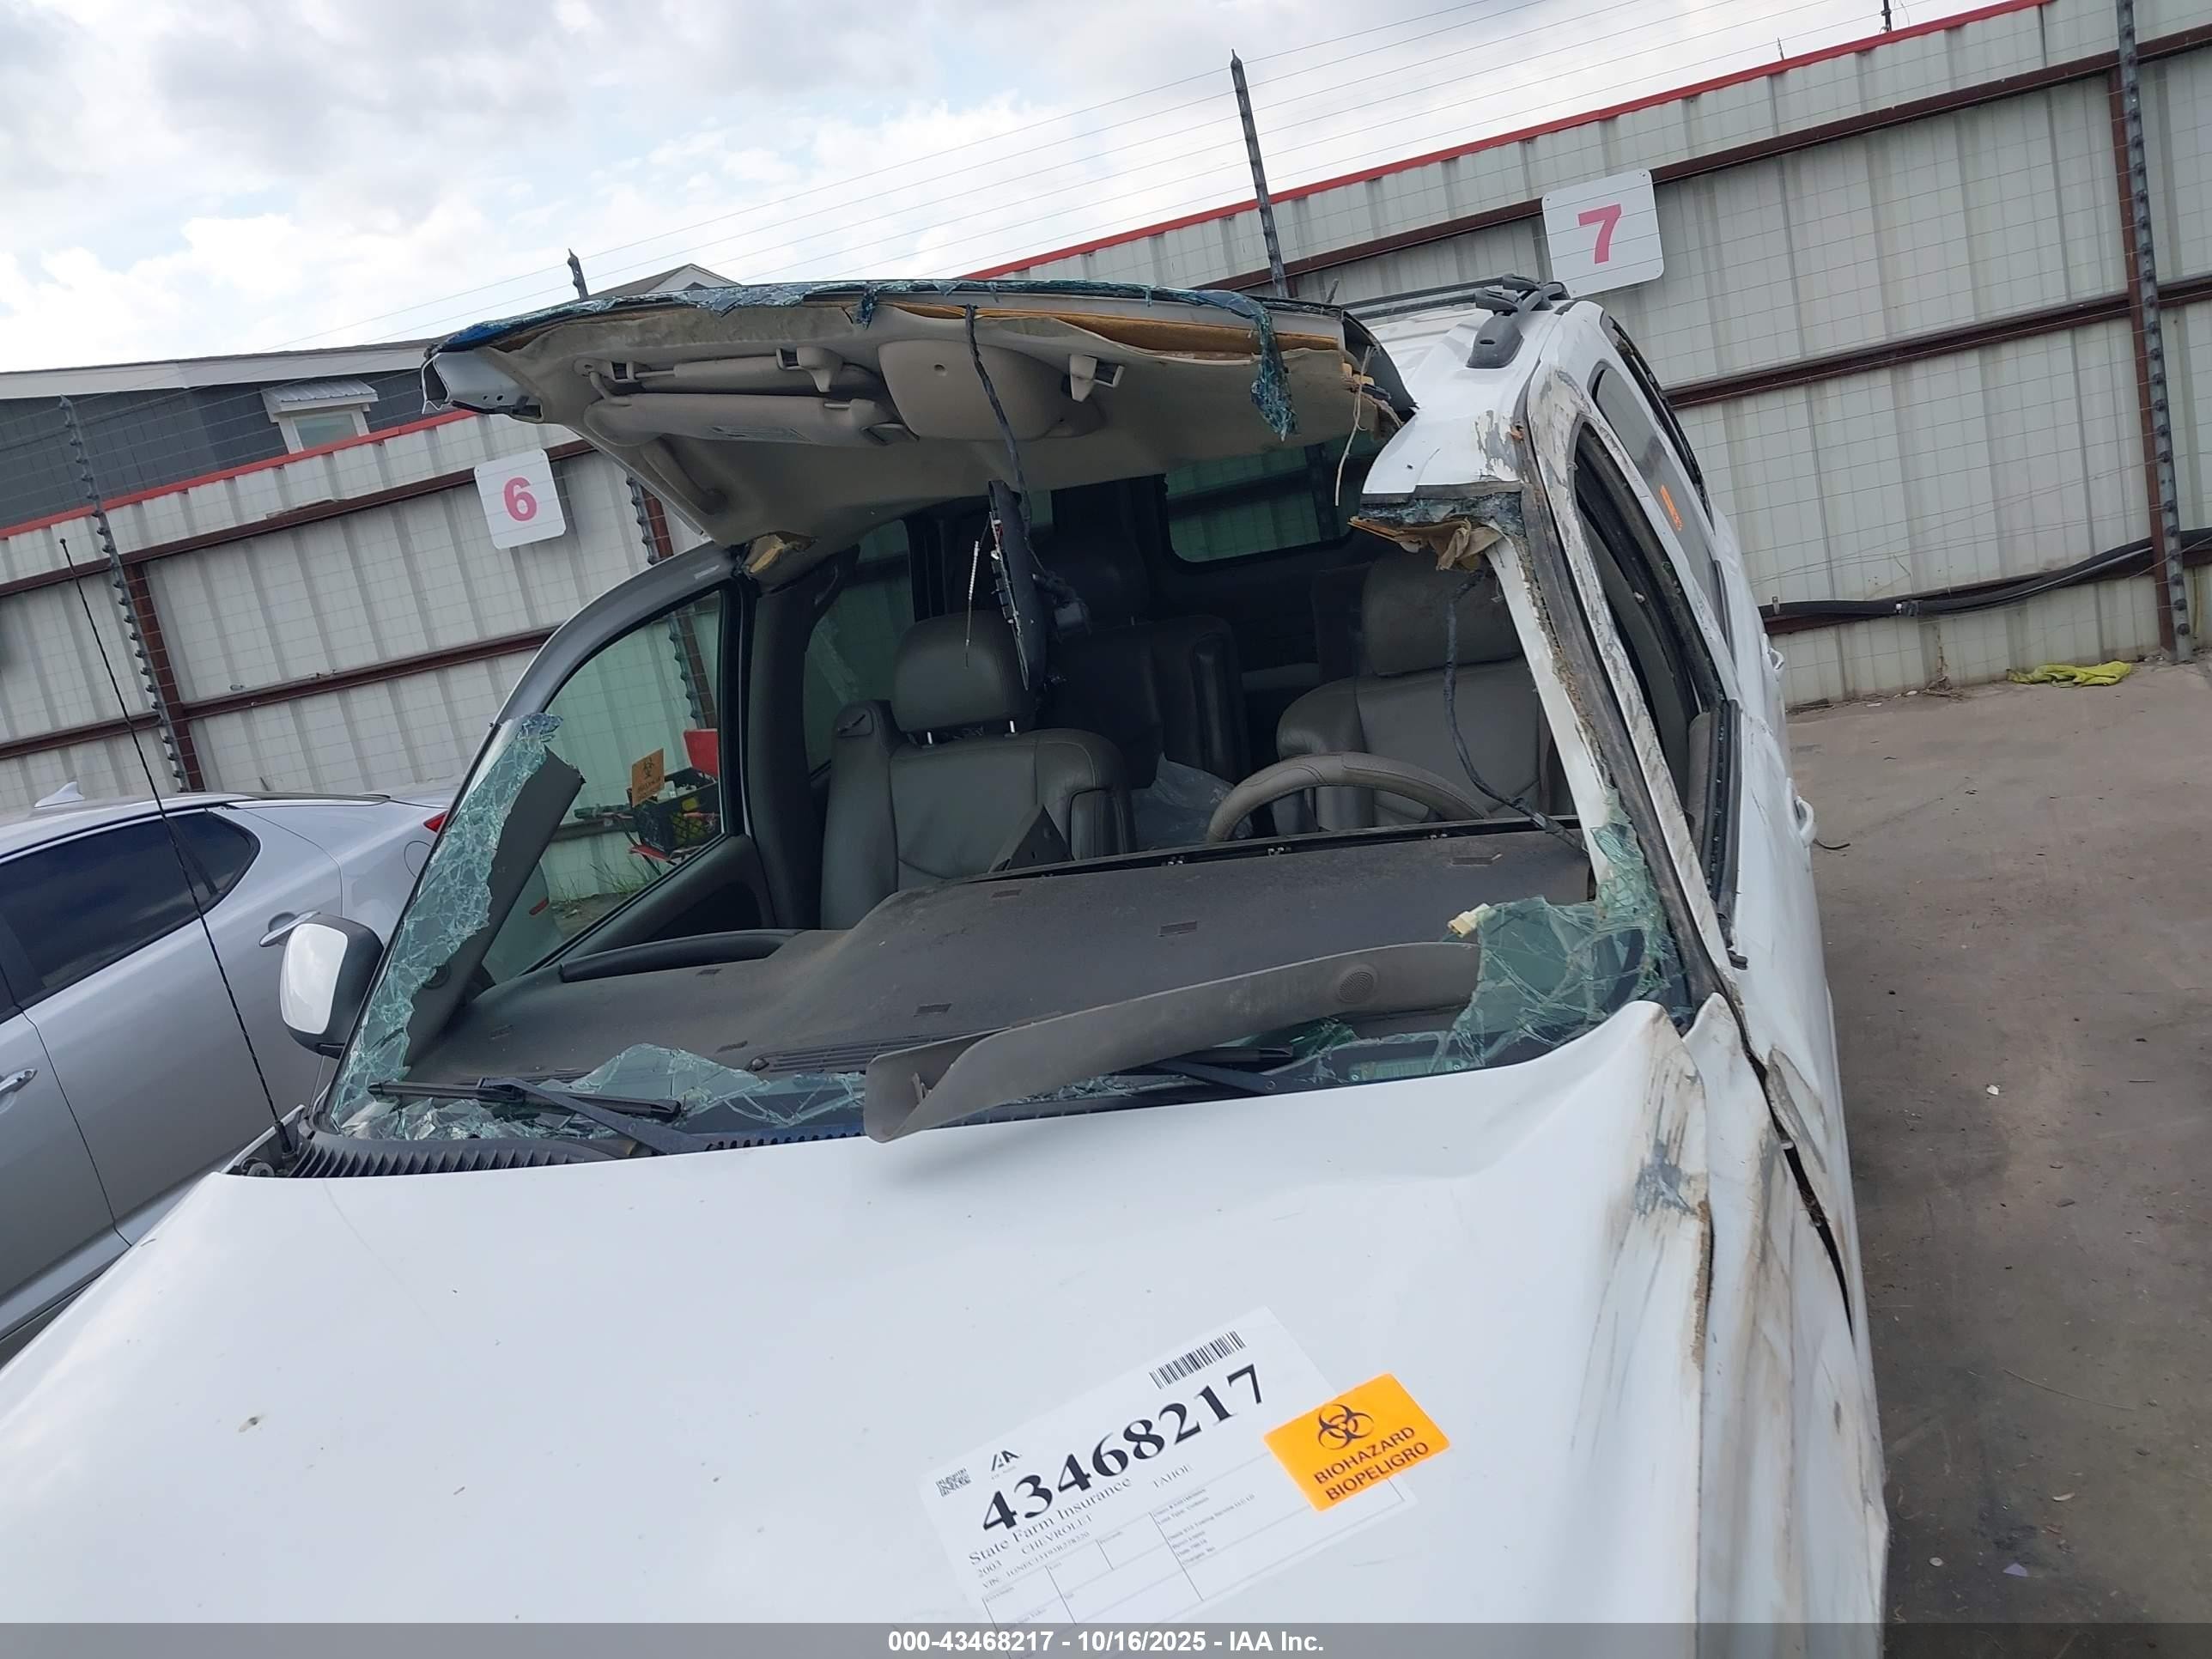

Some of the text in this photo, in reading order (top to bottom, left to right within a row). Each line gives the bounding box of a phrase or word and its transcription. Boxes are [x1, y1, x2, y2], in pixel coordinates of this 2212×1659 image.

[1577, 204, 1622, 264] 7
[503, 477, 538, 522] 6
[982, 1364, 1263, 1531] 43468217
[1314, 1426, 1415, 1485] BIOHAZARD
[1326, 1442, 1429, 1501] BIOPELIGRO
[968, 1538, 1010, 1565] State
[1012, 1517, 1055, 1543] Farm
[1056, 1476, 1133, 1522] Insurance
[1020, 1514, 1094, 1555] CHEVROLET
